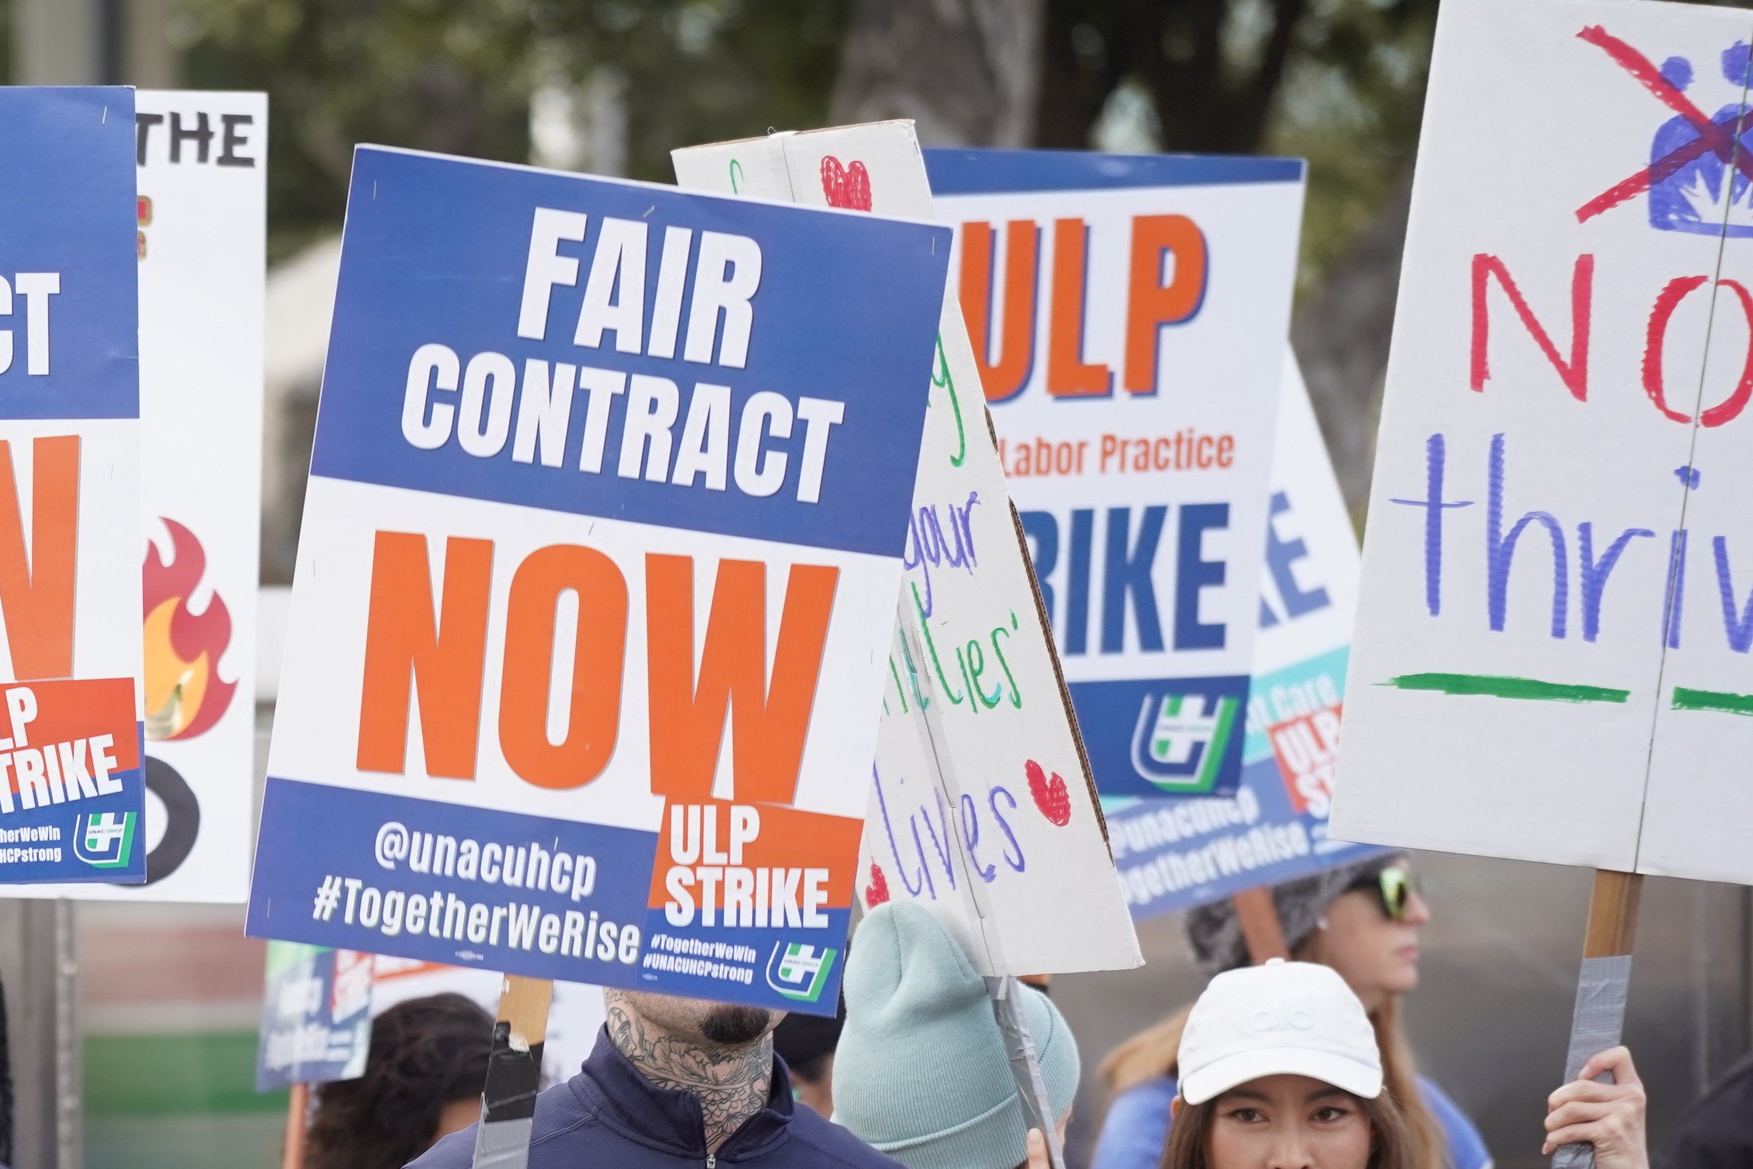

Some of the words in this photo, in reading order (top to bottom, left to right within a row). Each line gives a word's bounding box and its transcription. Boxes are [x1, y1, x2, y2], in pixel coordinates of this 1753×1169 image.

[135, 111, 255, 168] THE
[516, 206, 763, 371] FAIR
[959, 213, 1209, 402] ULP
[401, 342, 845, 505] CONTRACT
[1000, 436, 1087, 478] Labor
[1099, 429, 1236, 474] Practice
[1016, 503, 1231, 657] RIKE
[355, 529, 842, 806] NOW
[374, 820, 597, 903] @unacuhcp
[669, 804, 761, 867] ULP
[313, 874, 641, 965] #TogetherWeRise
[665, 867, 829, 929] STRIKE
[643, 953, 754, 985] #UNACUHCPstrong
[651, 934, 757, 963] #TogetherWeWin
